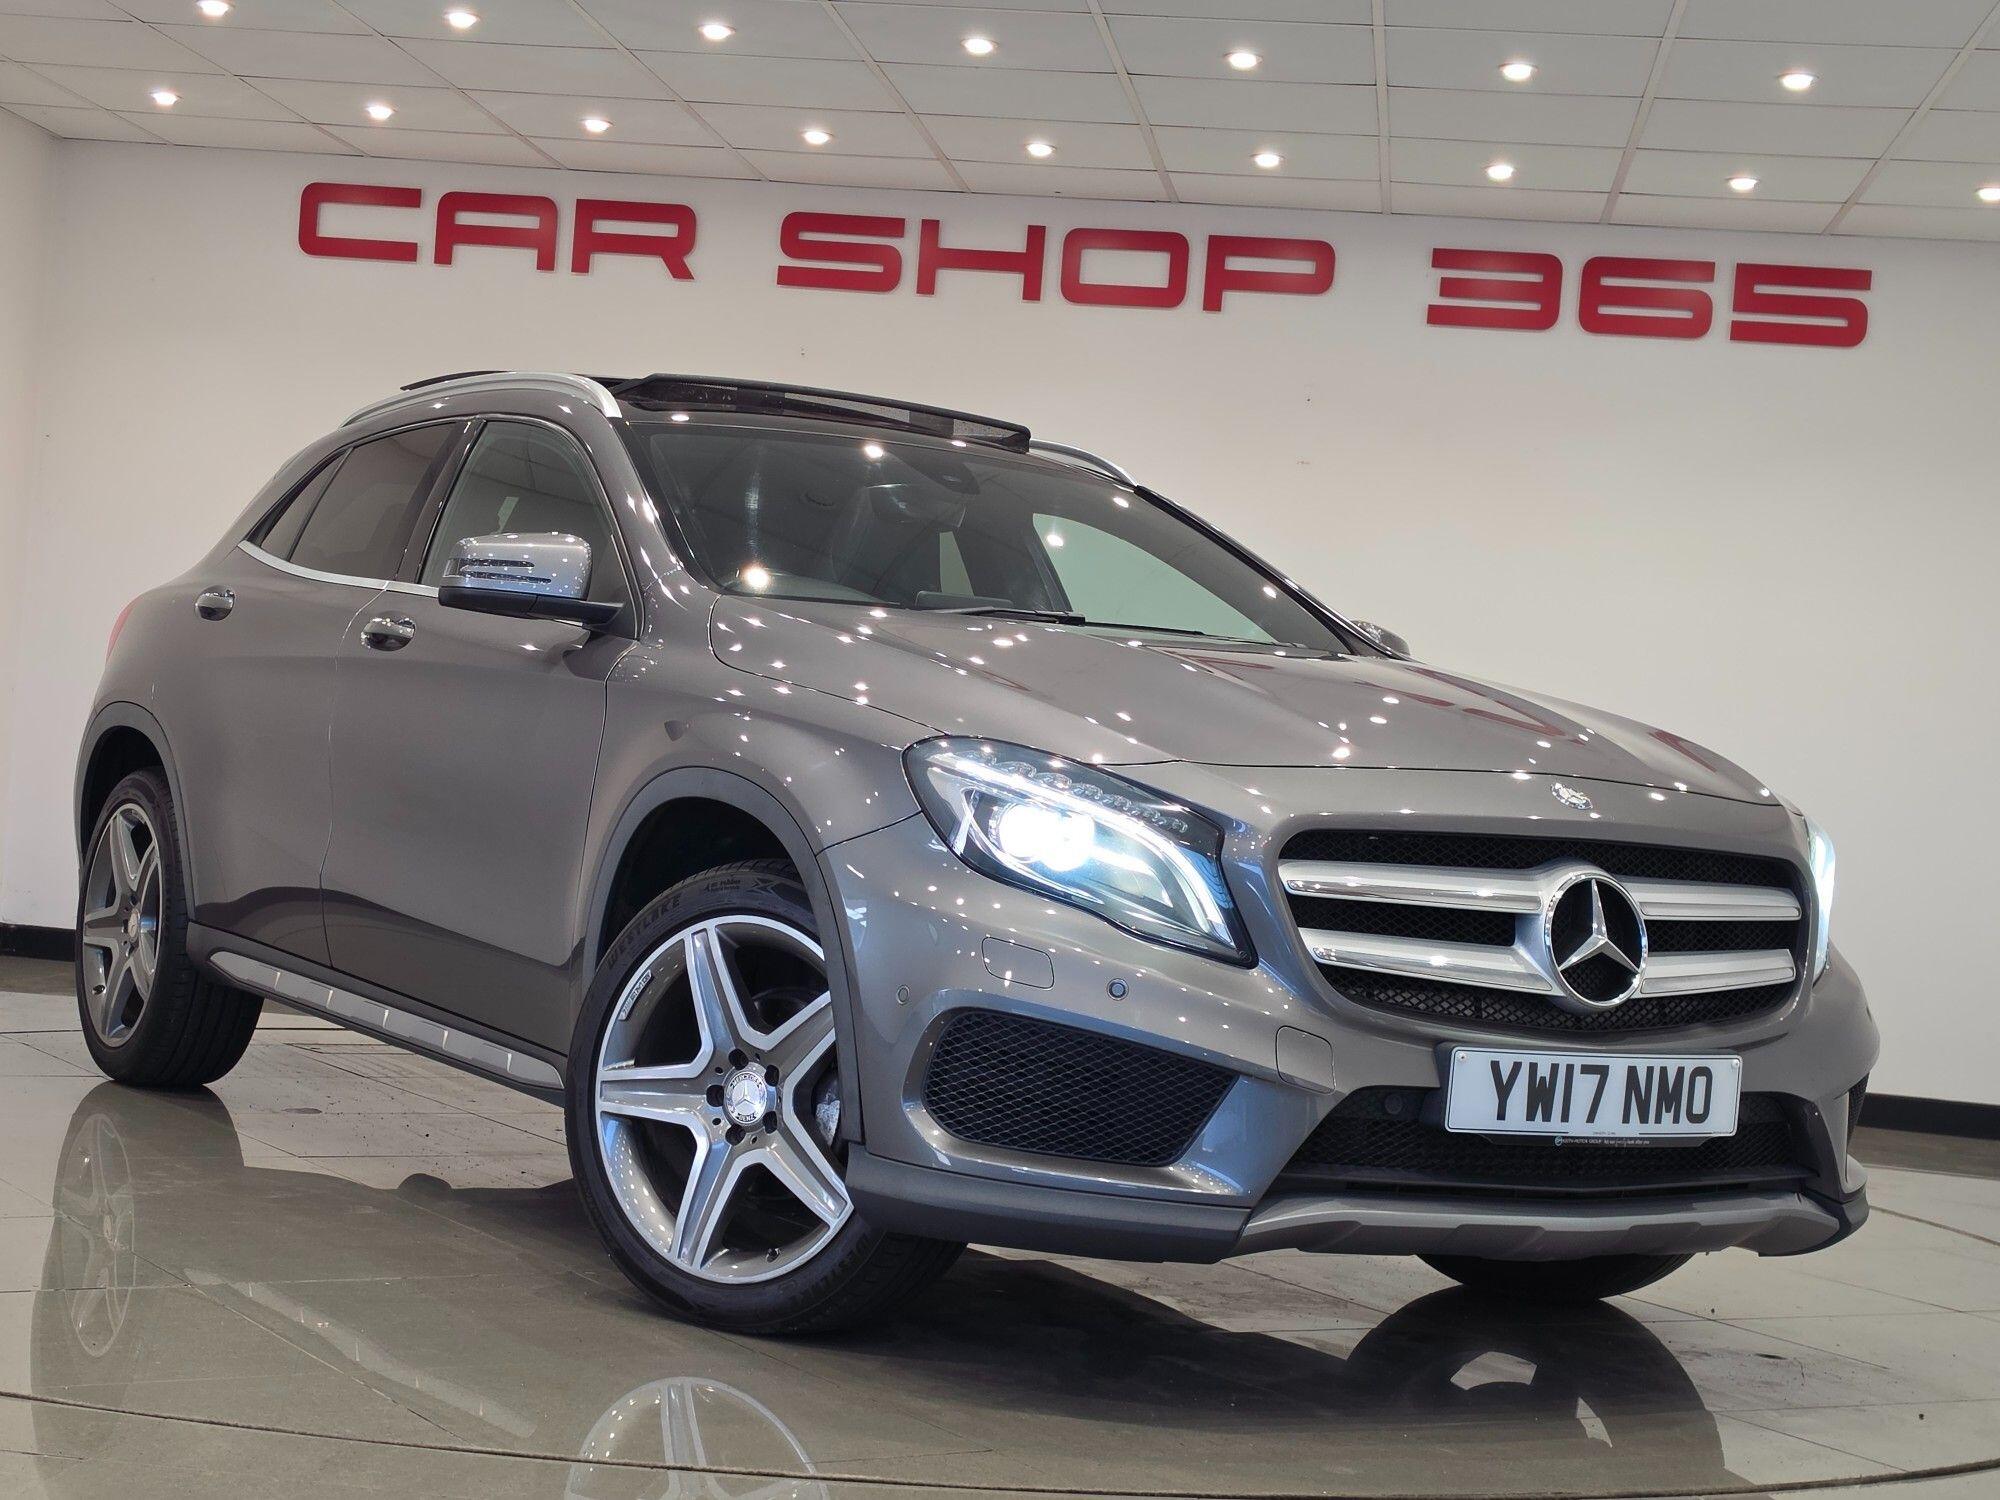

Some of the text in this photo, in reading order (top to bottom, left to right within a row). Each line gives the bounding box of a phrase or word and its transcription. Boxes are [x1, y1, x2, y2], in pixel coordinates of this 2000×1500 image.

[298, 181, 1872, 349] CAR SHOP 365
[738, 1113, 756, 1122] BENZ
[1490, 1059, 1714, 1125] YW17 NMO
